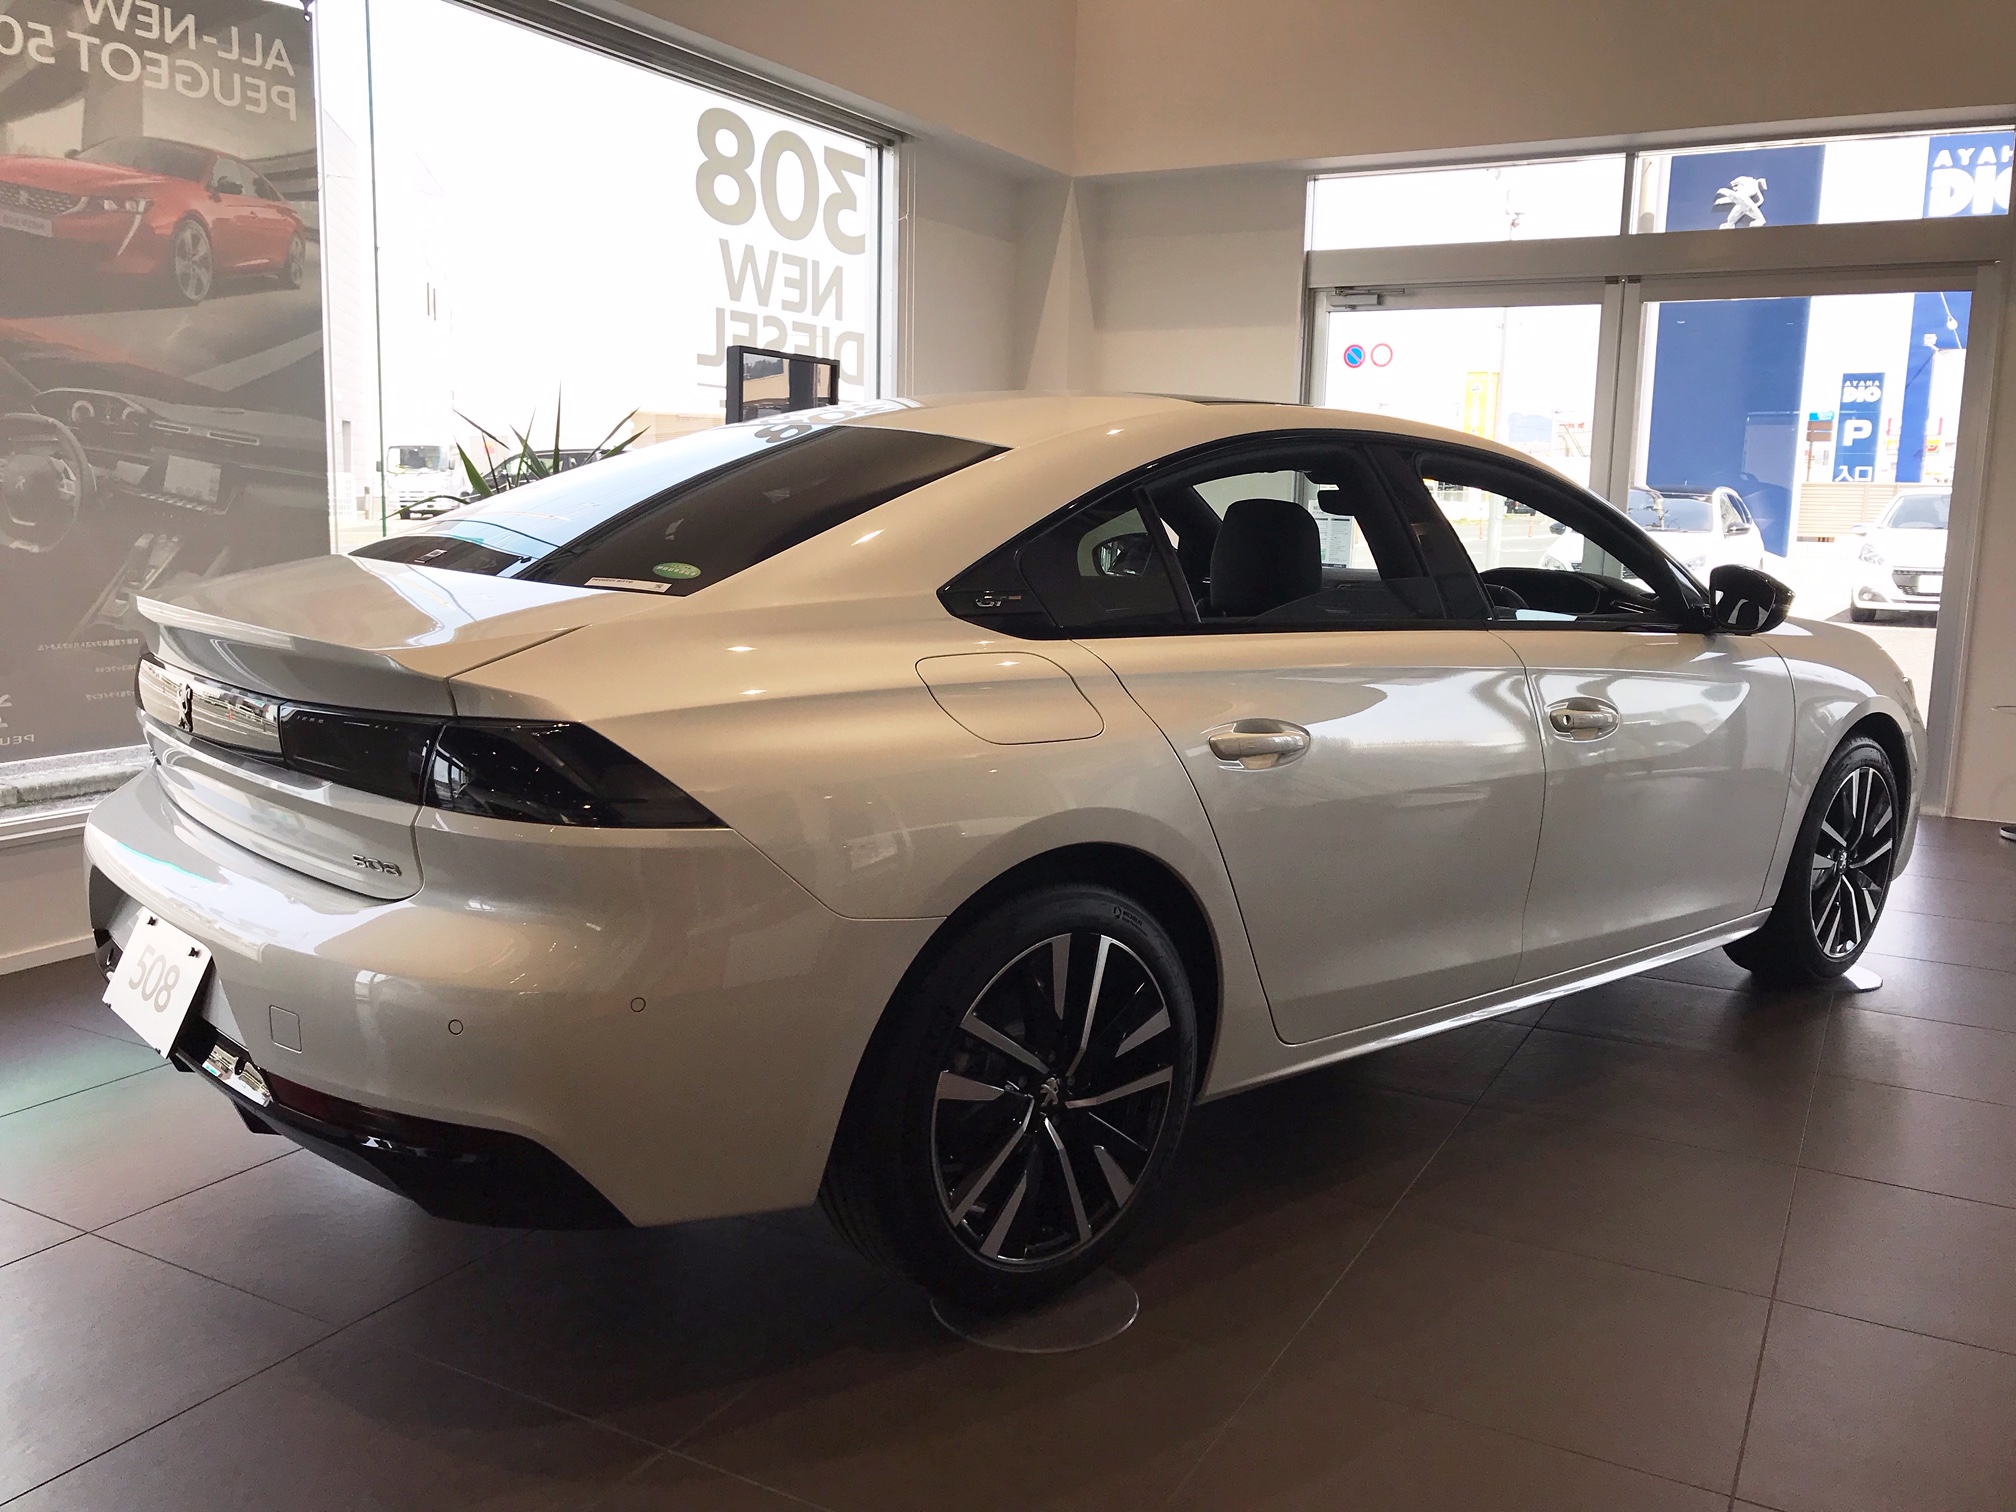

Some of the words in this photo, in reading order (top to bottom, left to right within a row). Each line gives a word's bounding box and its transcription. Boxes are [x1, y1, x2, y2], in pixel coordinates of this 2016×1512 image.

[1842, 386, 1882, 403] DIO
[1843, 419, 1873, 447] P
[1834, 465, 1874, 482] 入口
[352, 853, 403, 877] 508
[128, 944, 181, 1013] 508
